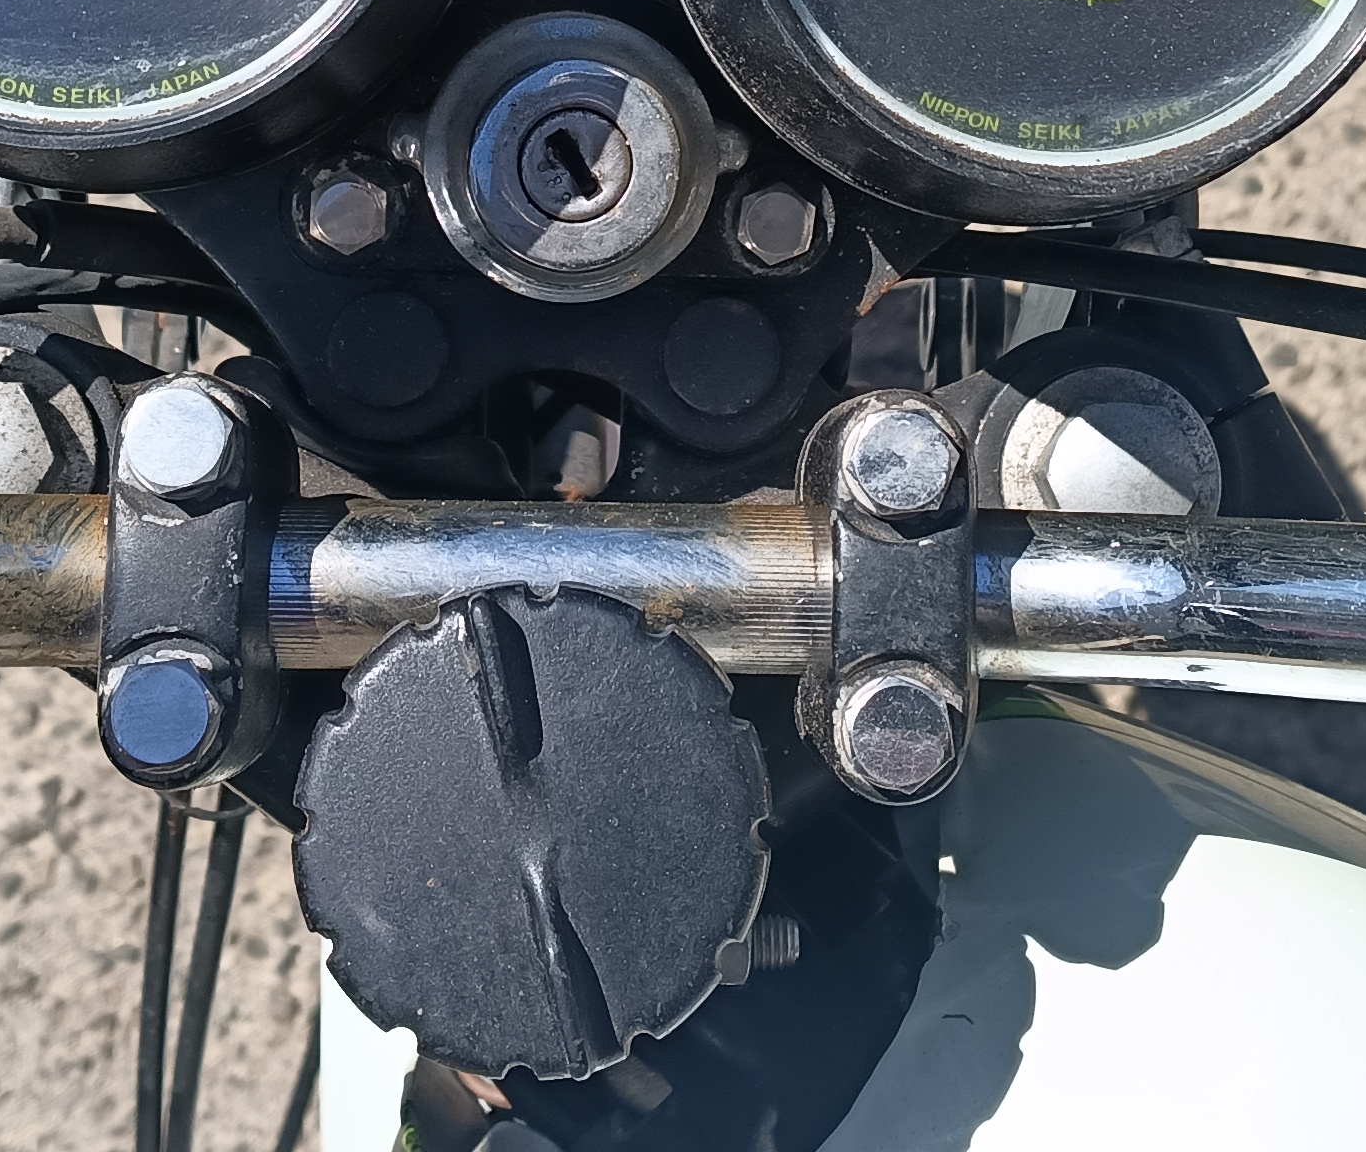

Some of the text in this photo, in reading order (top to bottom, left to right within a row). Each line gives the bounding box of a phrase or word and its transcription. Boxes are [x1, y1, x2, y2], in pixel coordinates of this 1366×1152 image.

[51, 86, 122, 104] SEIKI
[146, 61, 220, 99] JAPAN
[919, 91, 1000, 133] NIPPON
[1018, 121, 1081, 140] SEIKI
